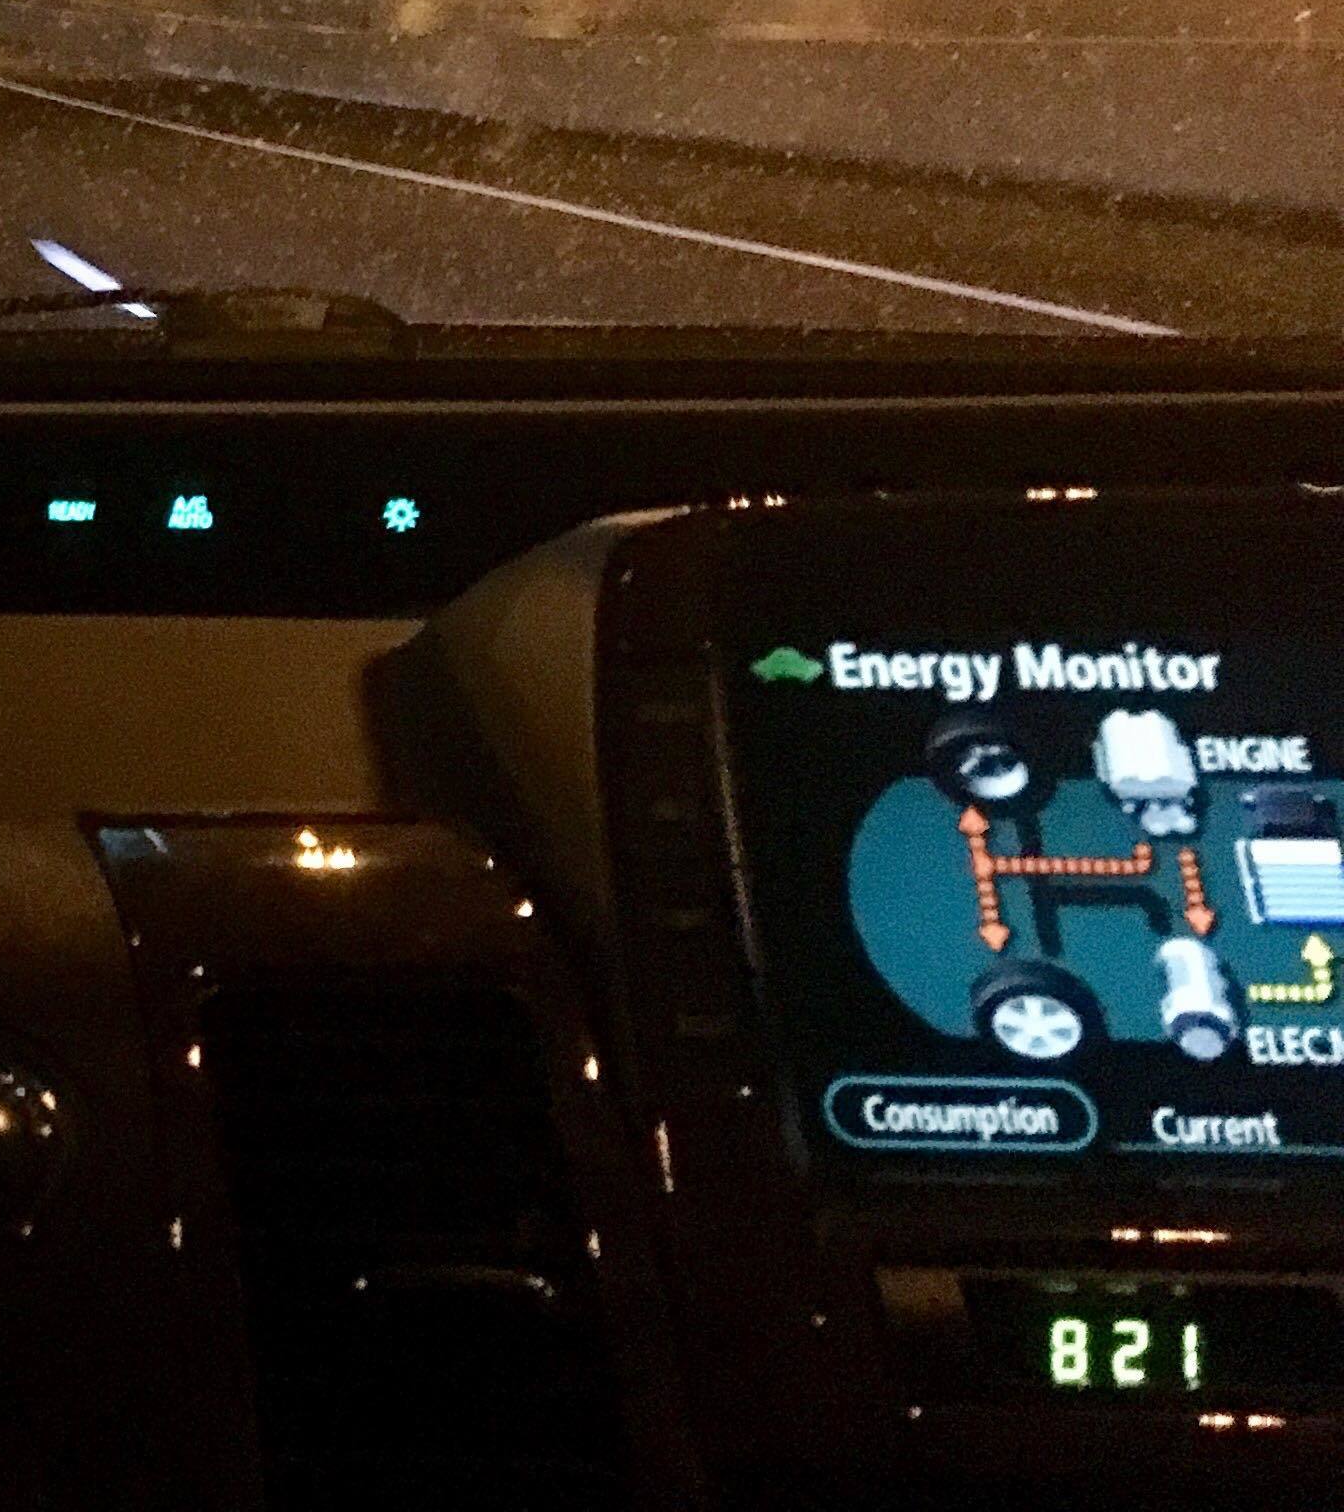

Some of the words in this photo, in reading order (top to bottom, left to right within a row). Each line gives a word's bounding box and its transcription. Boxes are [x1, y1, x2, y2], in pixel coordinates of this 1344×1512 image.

[828, 640, 1003, 701] Energy
[1013, 642, 1221, 691] Monitor
[1196, 735, 1313, 773] ENGINE
[862, 1095, 1059, 1141] Consumption
[1151, 1106, 1281, 1146] Current
